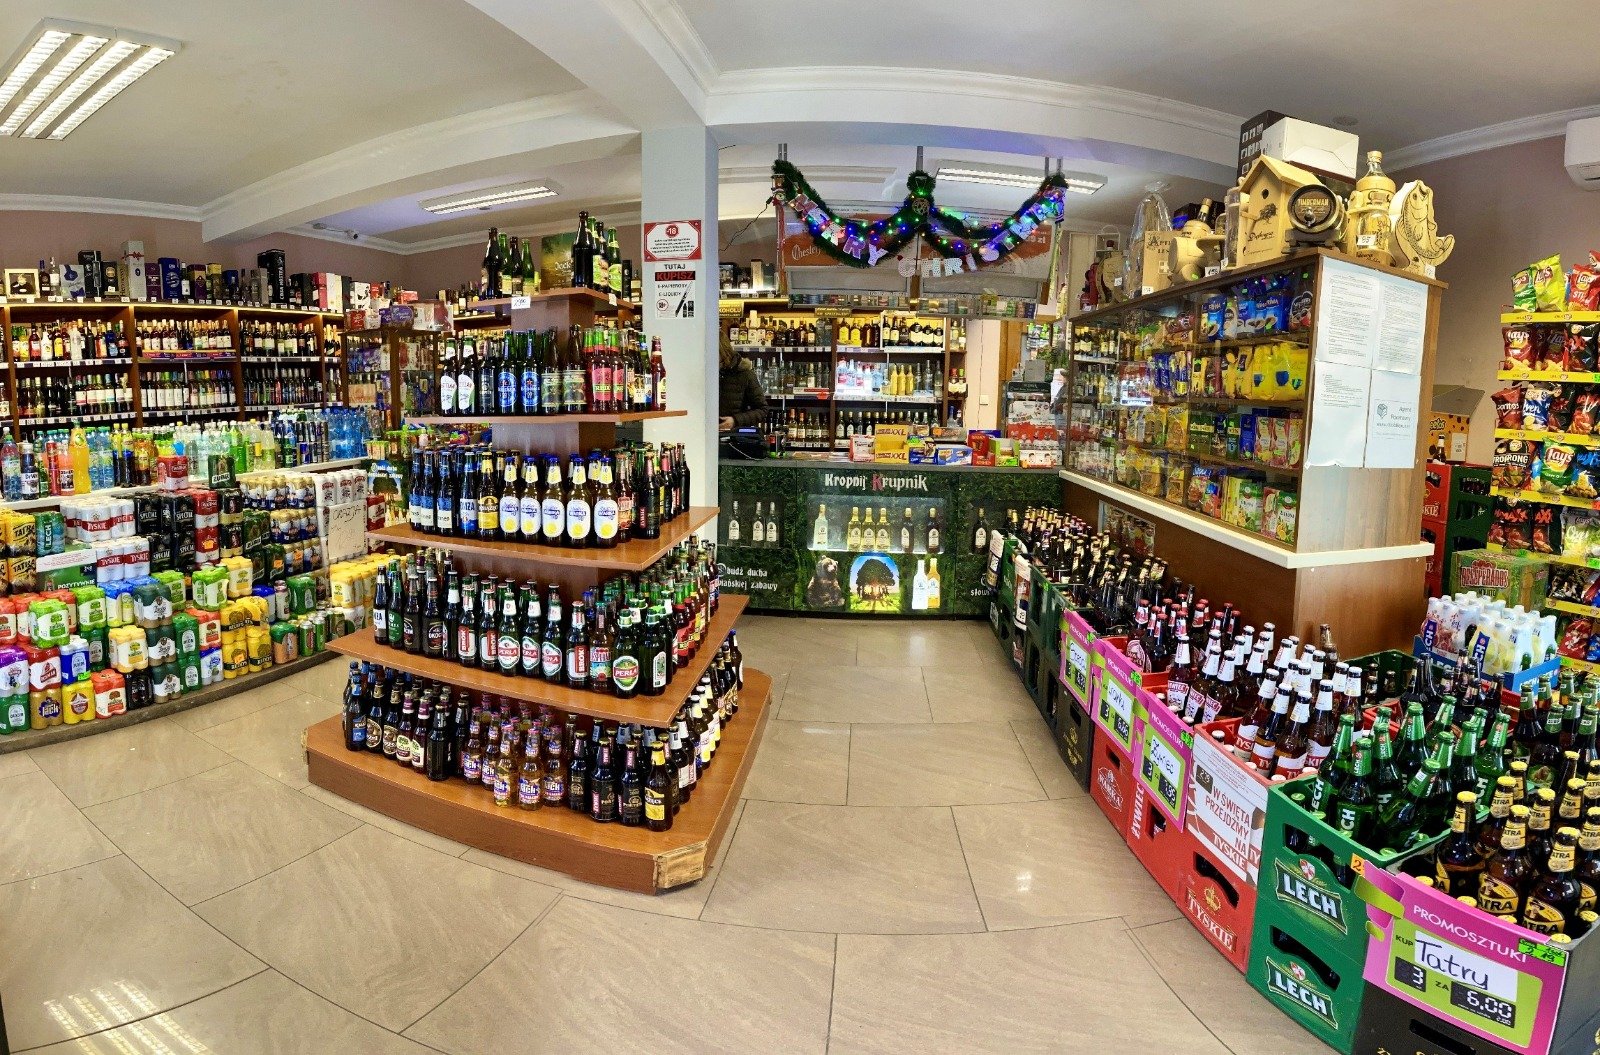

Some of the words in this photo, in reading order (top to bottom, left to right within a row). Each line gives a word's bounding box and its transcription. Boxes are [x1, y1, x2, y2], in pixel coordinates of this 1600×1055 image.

[657, 271, 693, 280] KUPISZ
[872, 474, 928, 491] Krupnik
[747, 569, 767, 577] ducha
[751, 582, 778, 591] zabawy
[1213, 786, 1220, 800] W
[1213, 832, 1246, 870] TYSKIE
[1235, 837, 1247, 857] NA
[1283, 873, 1337, 919] LECH
[1187, 893, 1234, 950] TYSKIE
[1414, 905, 1526, 963] PROMOSZTUKI
[1396, 935, 1414, 947] KUP
[1415, 939, 1489, 990] Tatry
[1275, 970, 1327, 1016] LECH
[1413, 966, 1424, 985] 3
[1435, 980, 1449, 991] ZA
[1466, 991, 1512, 1018] 6.00
